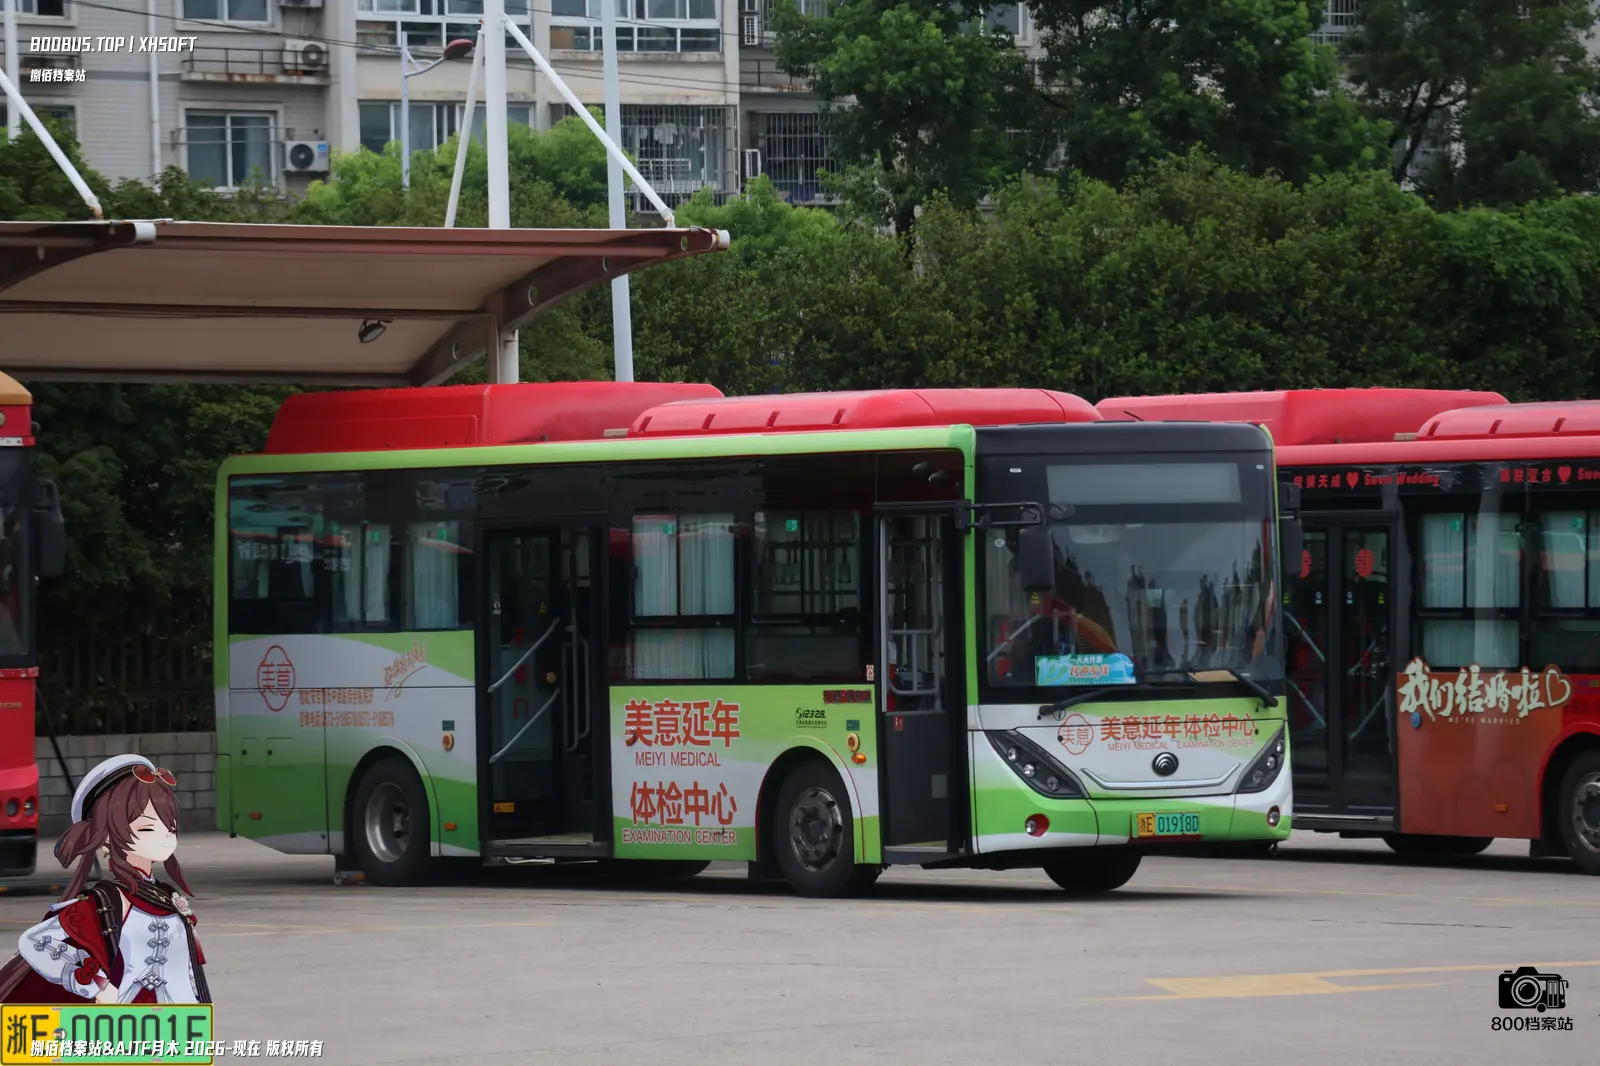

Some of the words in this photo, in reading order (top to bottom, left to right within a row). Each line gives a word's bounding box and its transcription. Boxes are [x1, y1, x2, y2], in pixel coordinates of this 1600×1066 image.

[1396, 472, 1440, 487] Wedding
[1398, 658, 1546, 721] 我们结婚啦
[624, 698, 741, 748] 美意延年
[1100, 712, 1257, 741] 美意延年体检中心
[1107, 743, 1131, 751] MEIYI
[1134, 741, 1168, 750] MEDICAL
[1176, 740, 1226, 749] EXAMINATION
[1227, 739, 1255, 748] CENTER
[635, 751, 666, 767] MEIYI
[670, 751, 721, 767] MEDICAL
[630, 780, 738, 827] 体检中心
[622, 828, 691, 844] EXAMINATION
[695, 830, 737, 845] CENTER
